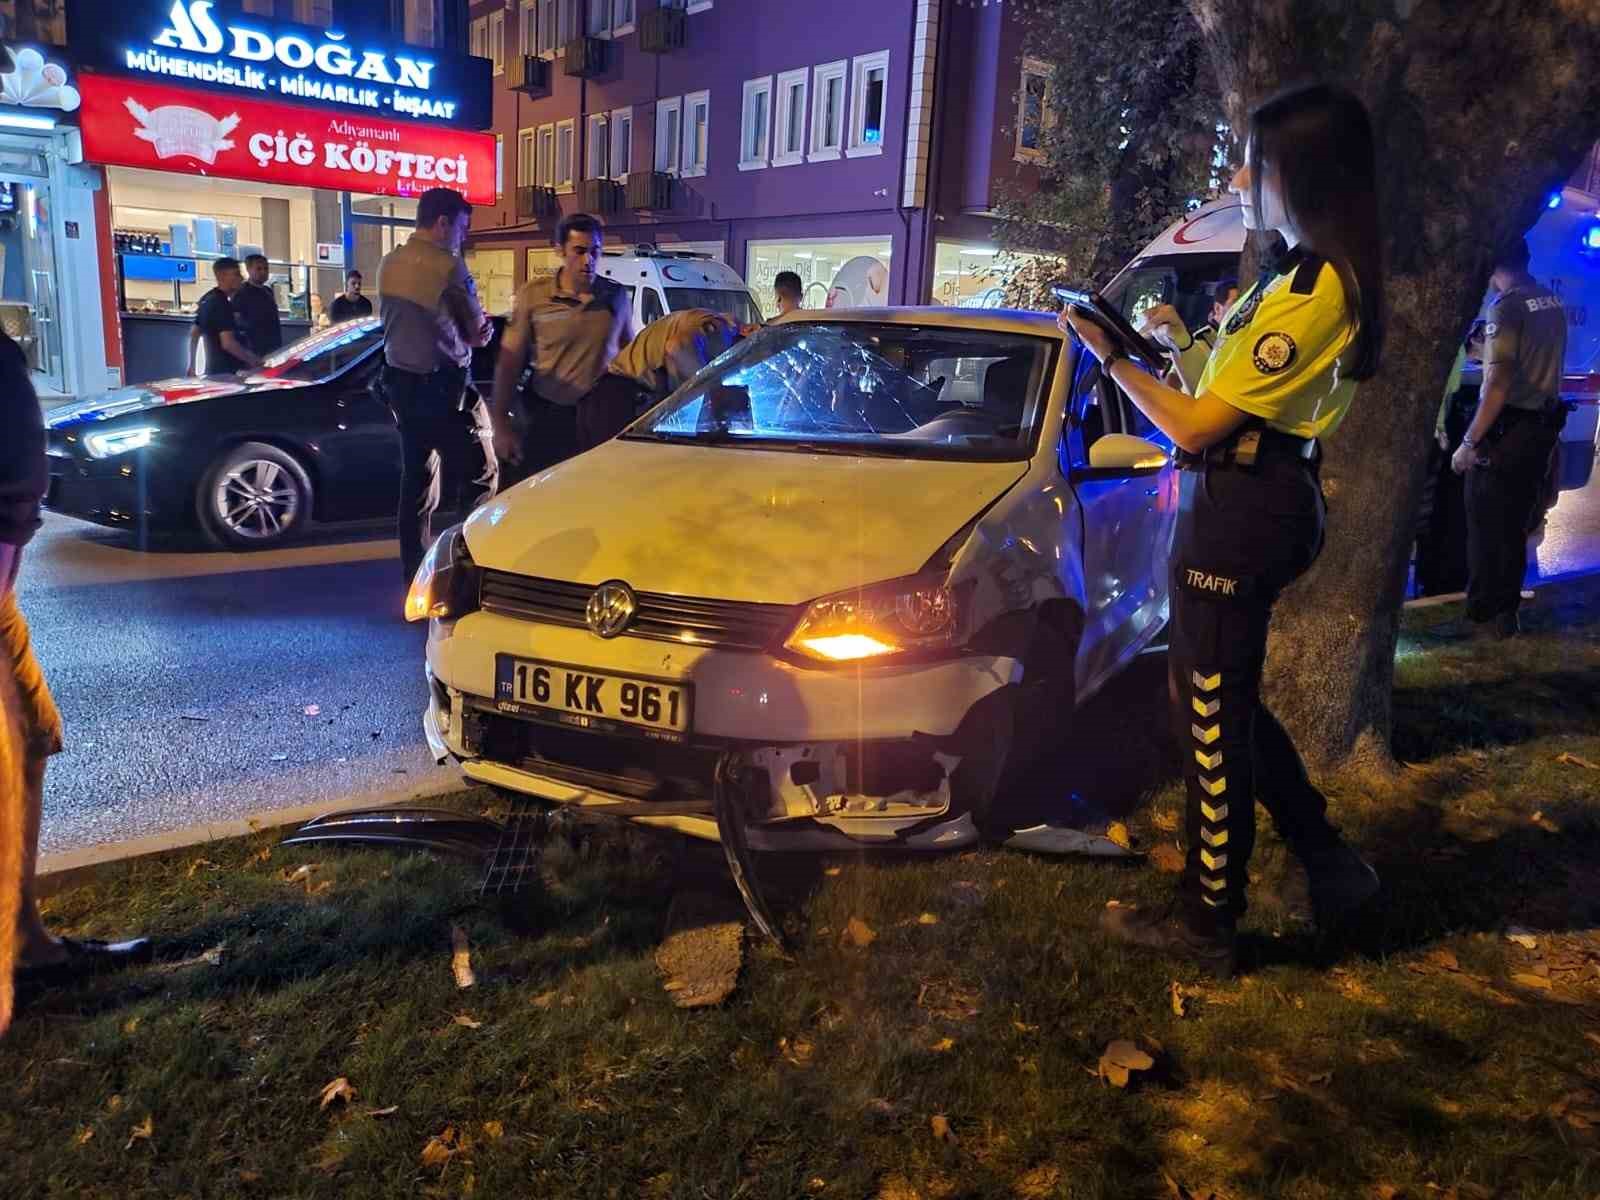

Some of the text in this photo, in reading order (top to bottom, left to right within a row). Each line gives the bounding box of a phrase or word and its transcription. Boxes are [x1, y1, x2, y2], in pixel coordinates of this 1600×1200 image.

[126, 48, 456, 119] MÜHENDİSLİK MİMARLIK İNŞAAT
[227, 27, 435, 90] DOĞAN
[248, 129, 316, 168] ÇİĞ
[324, 141, 468, 184] KÖFTECİ
[327, 119, 400, 142] Adıyamanlı
[501, 665, 680, 727] TR 16 KK 961
